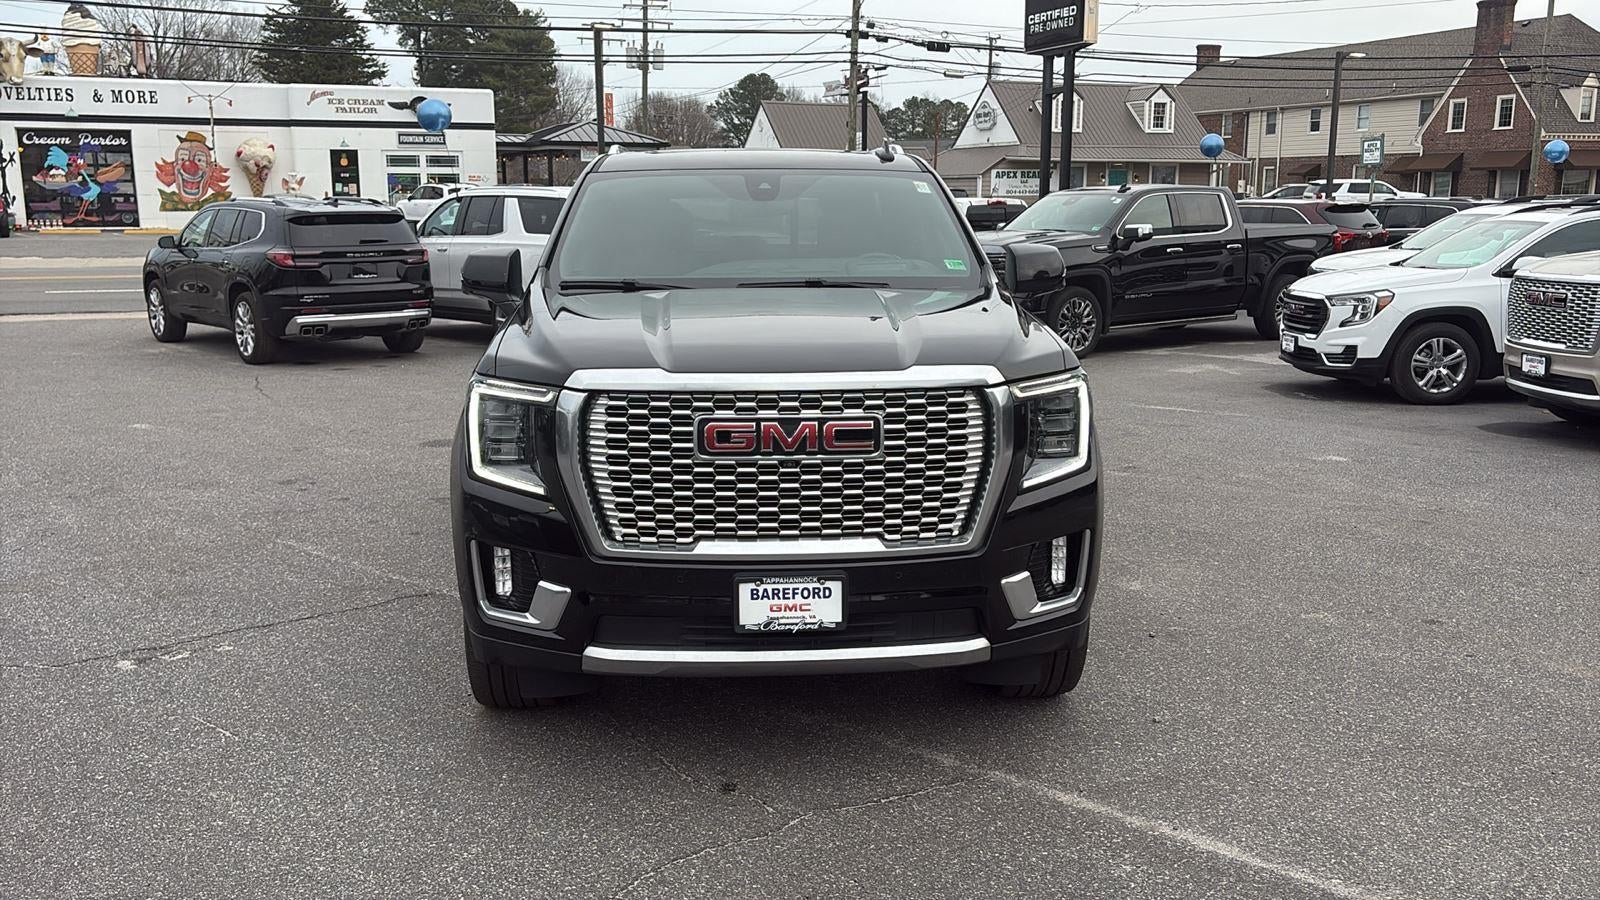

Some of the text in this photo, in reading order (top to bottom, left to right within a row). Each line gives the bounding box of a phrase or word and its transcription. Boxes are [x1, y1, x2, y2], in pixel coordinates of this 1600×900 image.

[1028, 5, 1077, 24] CERTIFIED
[1030, 17, 1074, 34] PRE-OWNED
[0, 86, 159, 104] VELTIES & MORE
[347, 98, 385, 106] CREAM
[335, 106, 378, 114] PARLOR
[22, 131, 128, 146] Cream Parlor
[400, 134, 445, 144] FOUNTAIN SERVICE
[995, 170, 1018, 179] APEX
[1526, 291, 1566, 308] GMC
[704, 421, 875, 452] GMC
[762, 576, 818, 584] TAPPAHANNOCK
[750, 587, 832, 600] BAREFORD
[769, 603, 811, 612] GMC
[760, 619, 822, 633] Bareford
